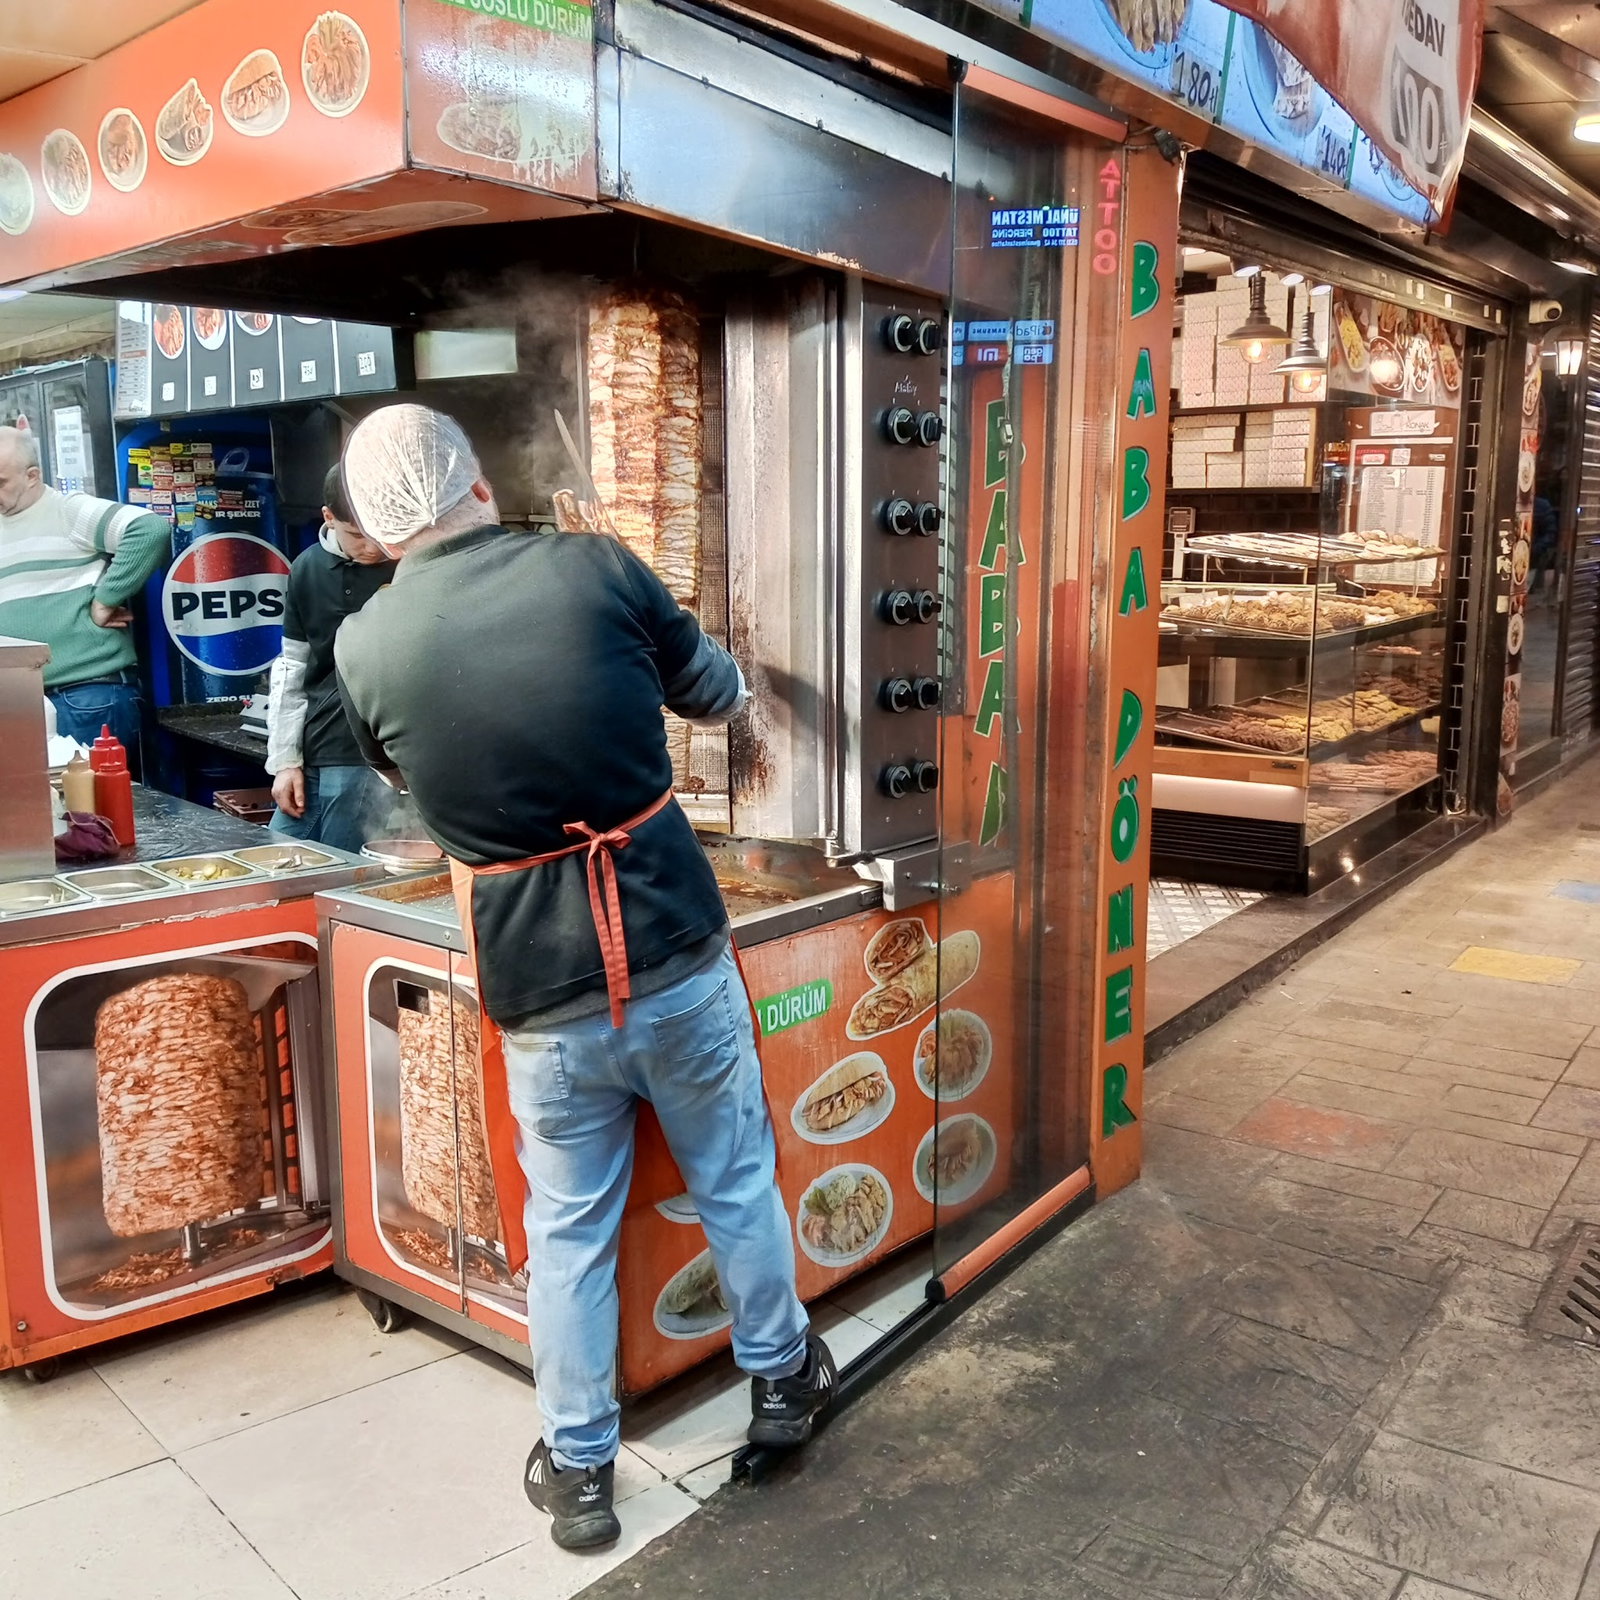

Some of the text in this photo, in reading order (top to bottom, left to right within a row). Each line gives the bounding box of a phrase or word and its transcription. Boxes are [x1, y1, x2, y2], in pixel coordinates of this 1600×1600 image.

[533, 0, 592, 40] DÜRÜM
[1118, 240, 1160, 617] BABA
[227, 510, 261, 519] ŞEKER
[171, 589, 288, 621] PEPS
[206, 694, 238, 703] ZERO
[1102, 688, 1145, 1140] DÖNER
[767, 985, 826, 1032] DÜRÜM
[762, 1402, 787, 1410] adidas
